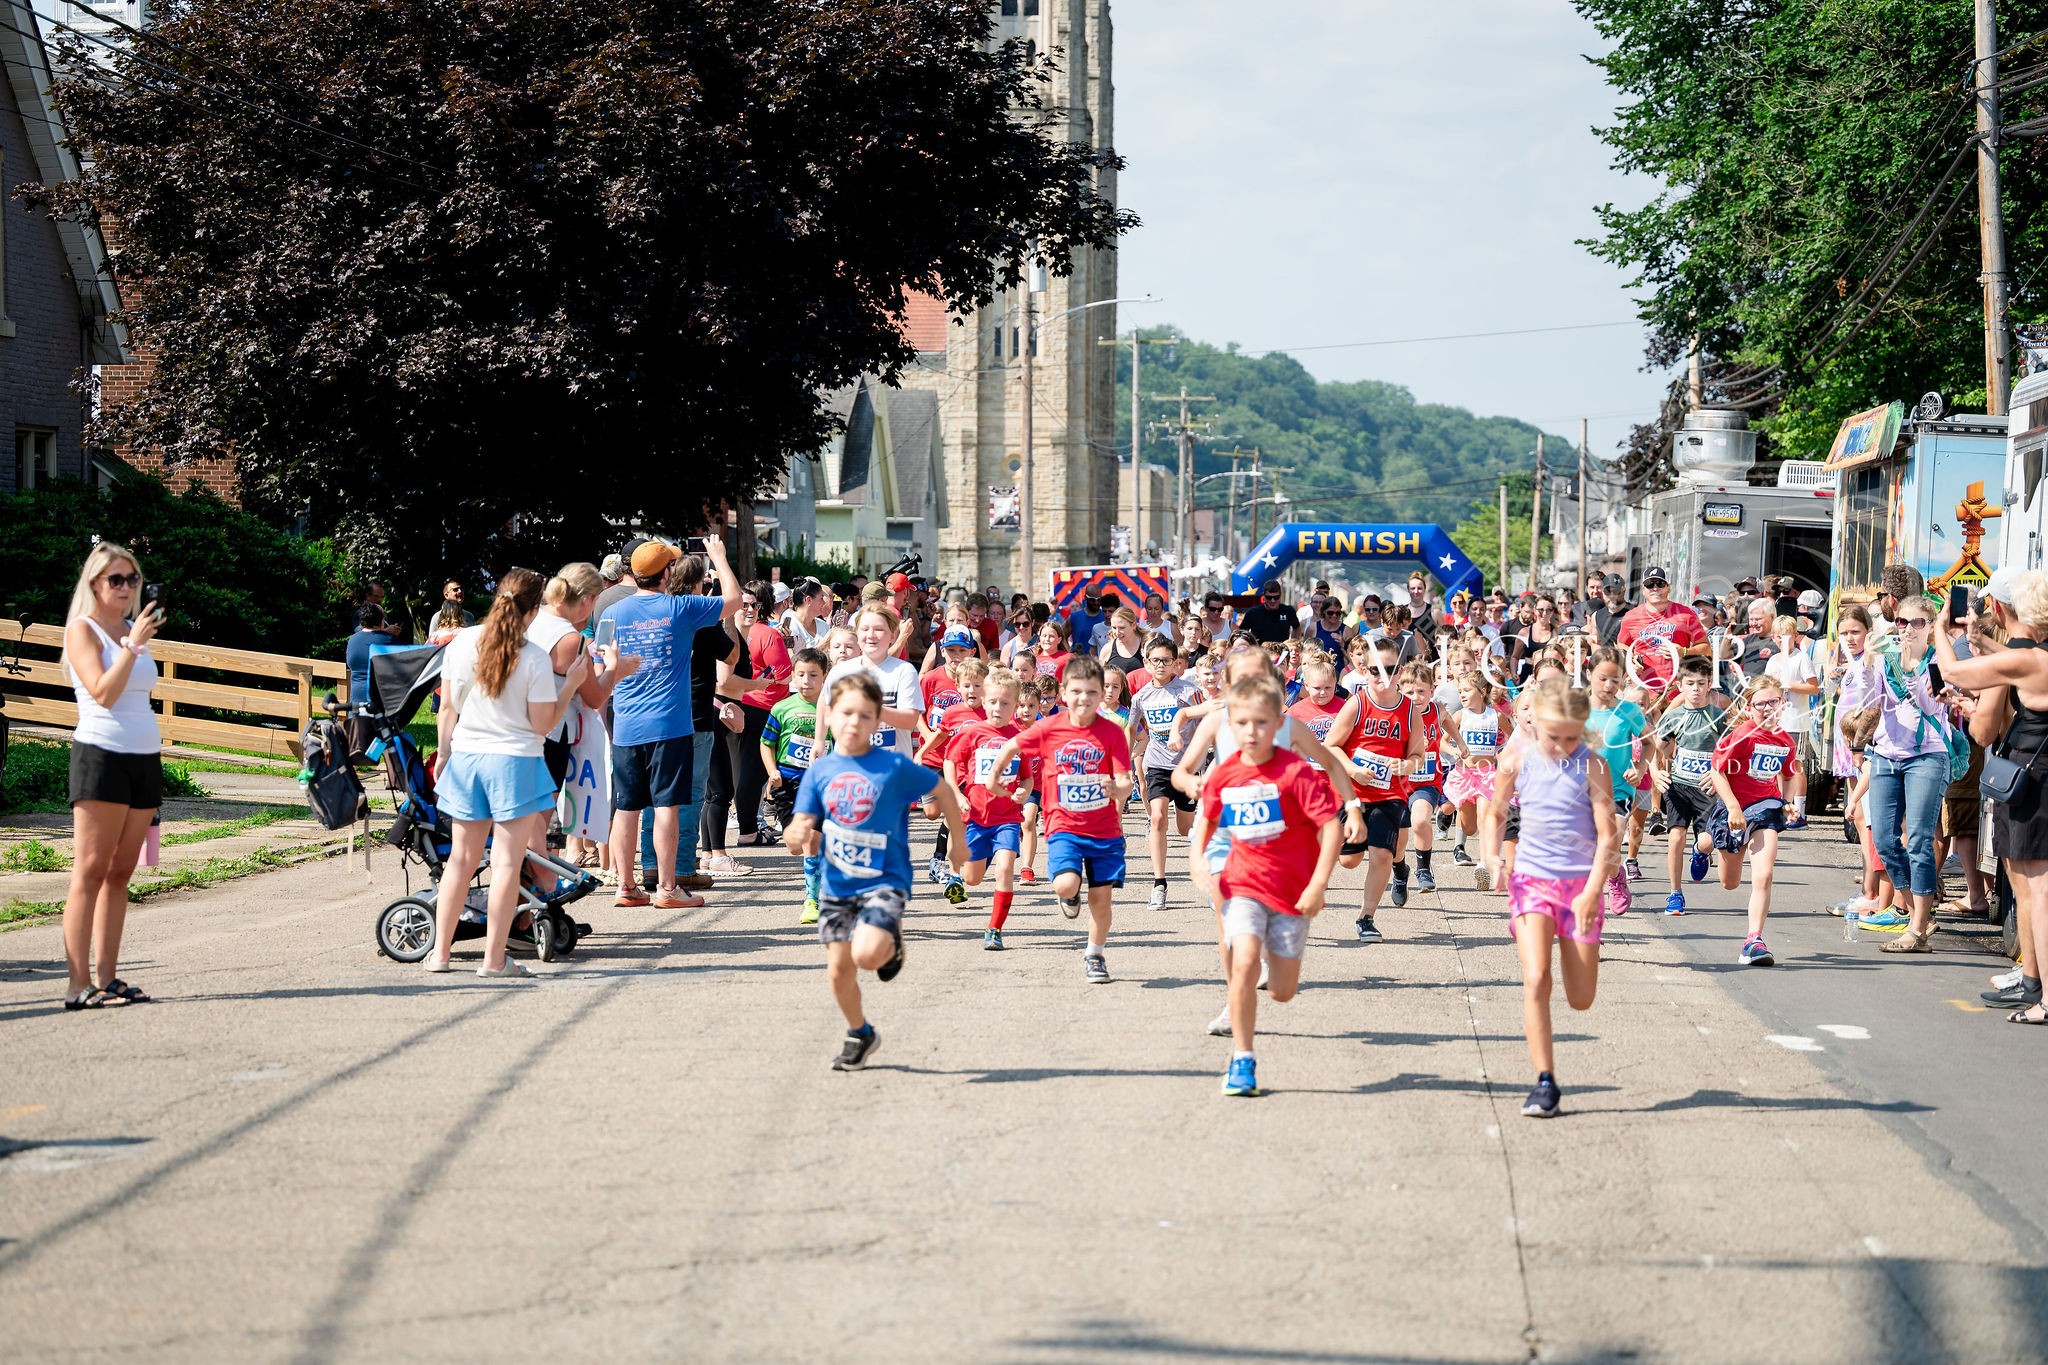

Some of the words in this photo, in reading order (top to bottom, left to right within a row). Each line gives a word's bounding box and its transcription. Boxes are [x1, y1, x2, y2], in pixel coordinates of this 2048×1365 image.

[1708, 508, 1738, 519] XNF-9569
[1298, 531, 1420, 554] FINISH
[1149, 709, 1173, 723] 556
[1364, 718, 1401, 740] USA
[1468, 732, 1491, 745] 131
[1056, 748, 1079, 763] Ford
[1081, 747, 1105, 762] City
[1682, 758, 1708, 773] 296
[1068, 785, 1101, 802] 652
[1230, 801, 1270, 826] 730
